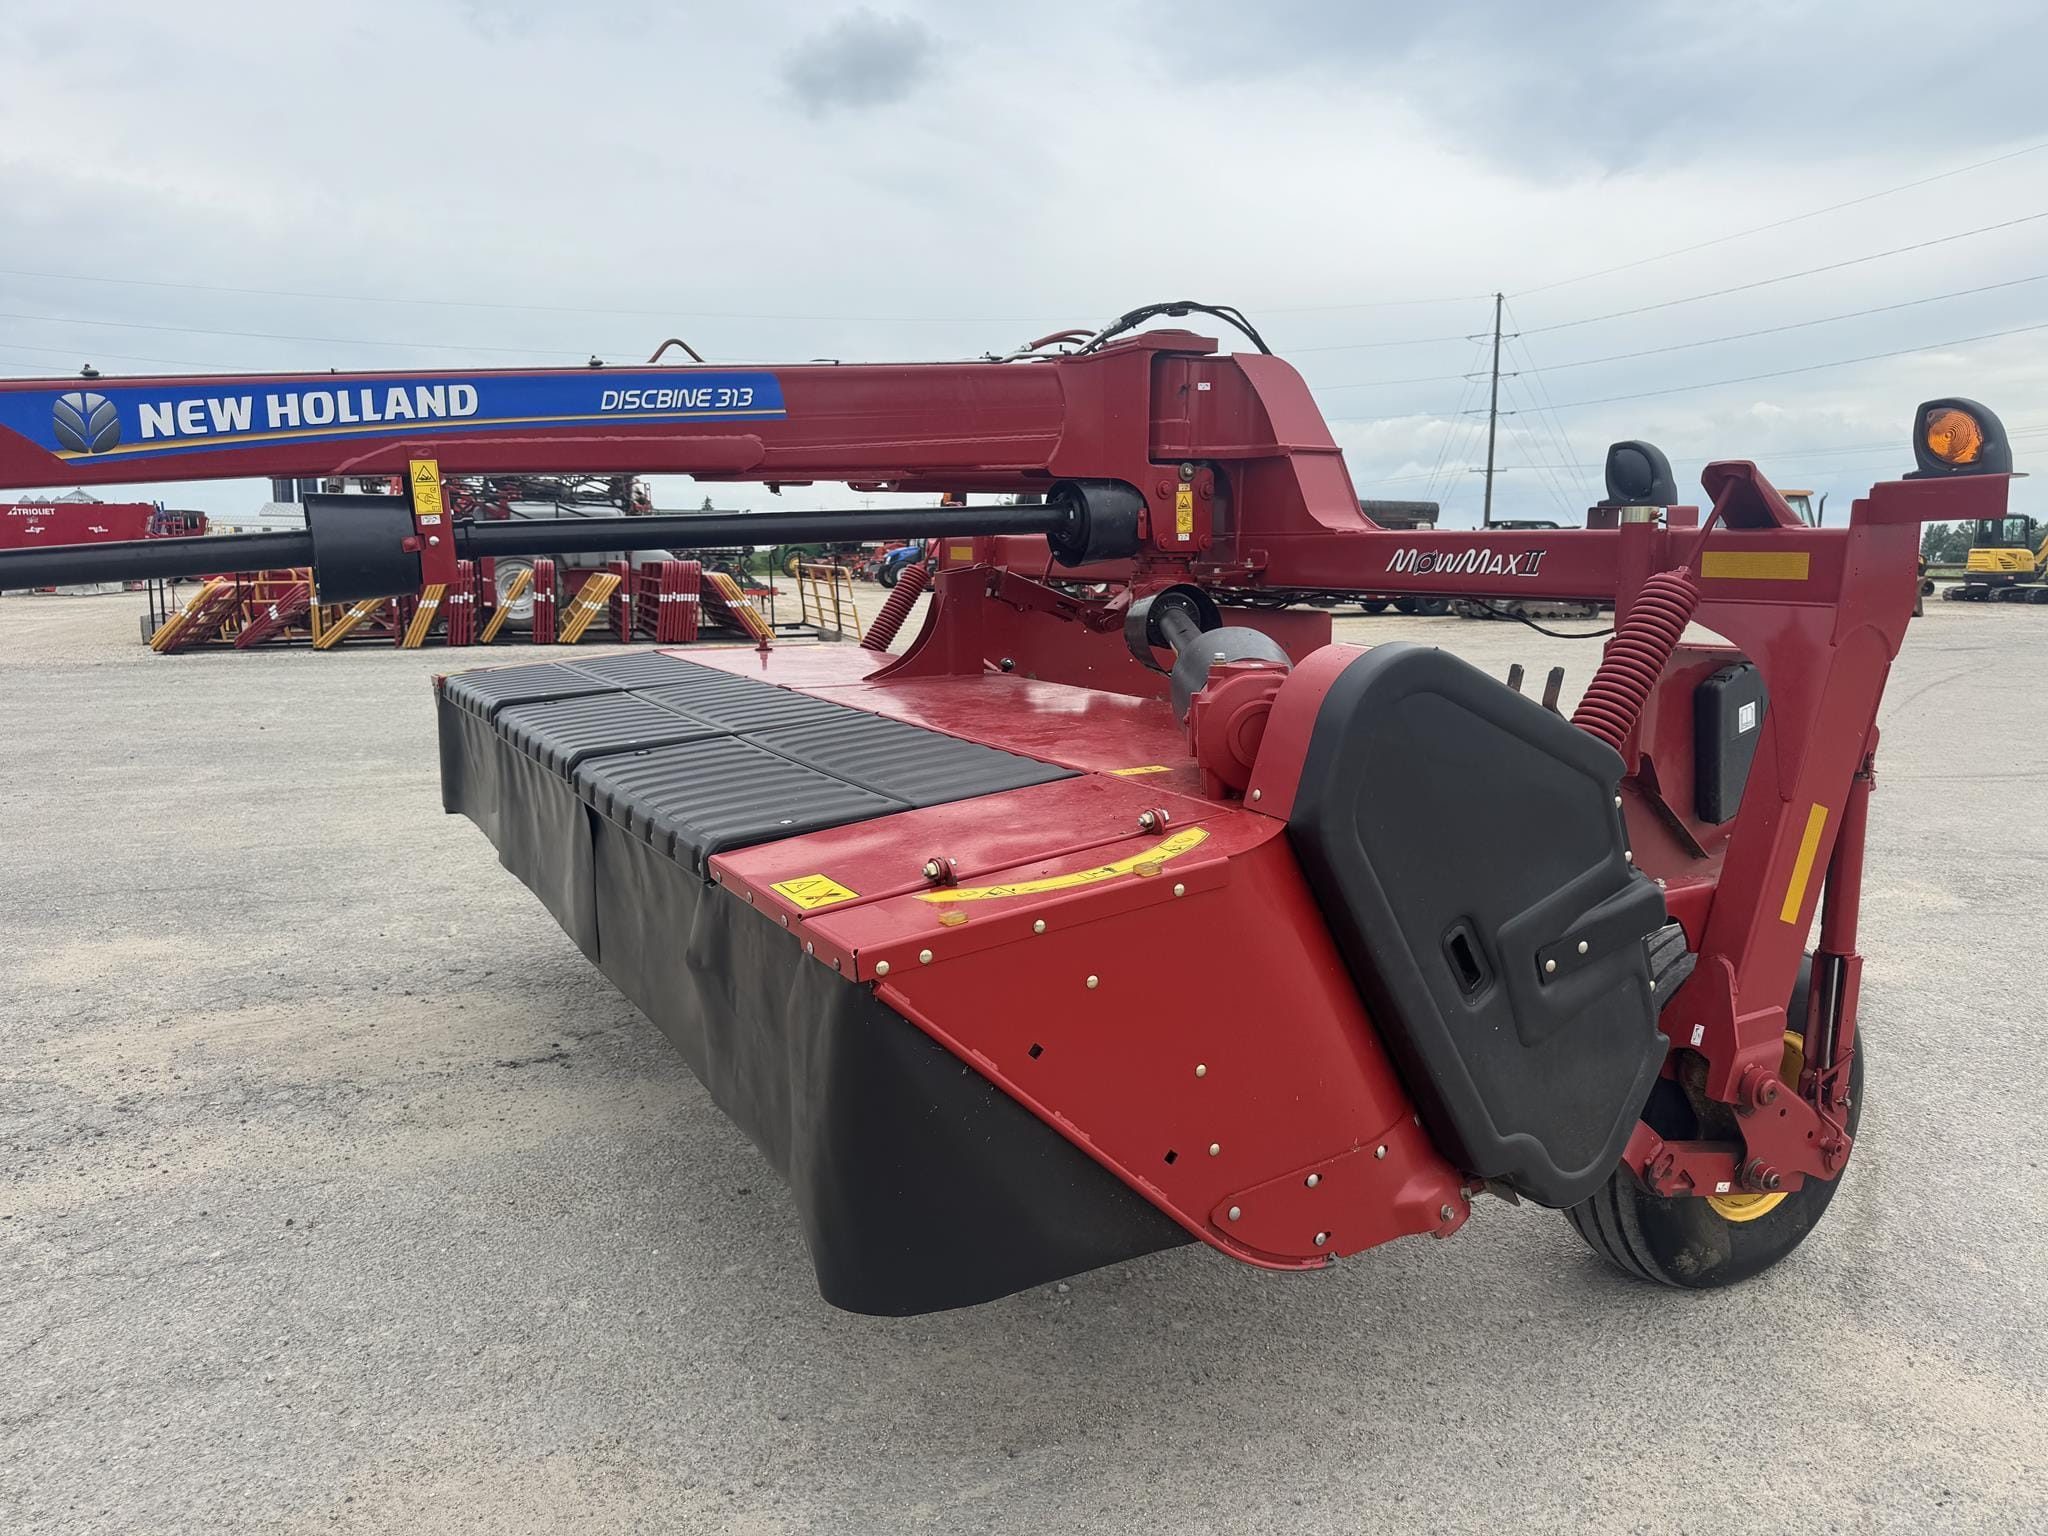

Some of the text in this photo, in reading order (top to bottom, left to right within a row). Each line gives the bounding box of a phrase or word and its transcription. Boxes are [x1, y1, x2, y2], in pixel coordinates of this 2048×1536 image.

[138, 384, 479, 439] NEW HOLLAND
[600, 387, 754, 411] DISCBINE 313
